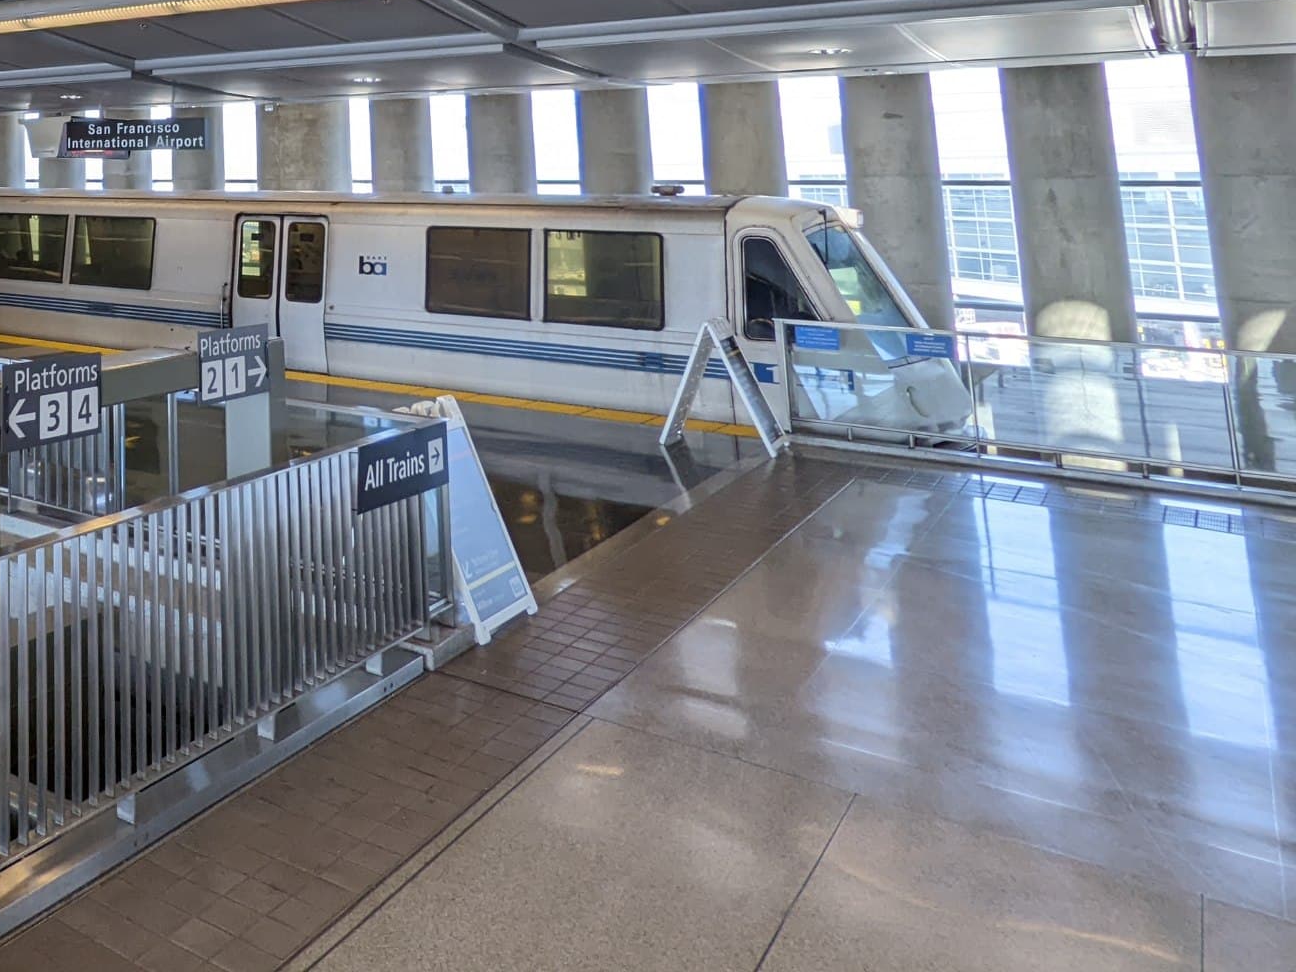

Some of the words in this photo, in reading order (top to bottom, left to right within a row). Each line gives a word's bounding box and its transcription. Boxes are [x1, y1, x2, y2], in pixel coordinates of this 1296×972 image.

[67, 135, 149, 149] International
[156, 135, 204, 149] Airport
[88, 123, 111, 135] San
[116, 122, 180, 135] Francisco
[200, 332, 261, 359] Platforms
[14, 363, 98, 394] Platforms
[207, 366, 218, 395] 2
[231, 361, 239, 389] 1
[47, 399, 61, 432] 3
[77, 393, 92, 425] 4
[364, 458, 384, 492] All
[386, 451, 425, 484] Trains
